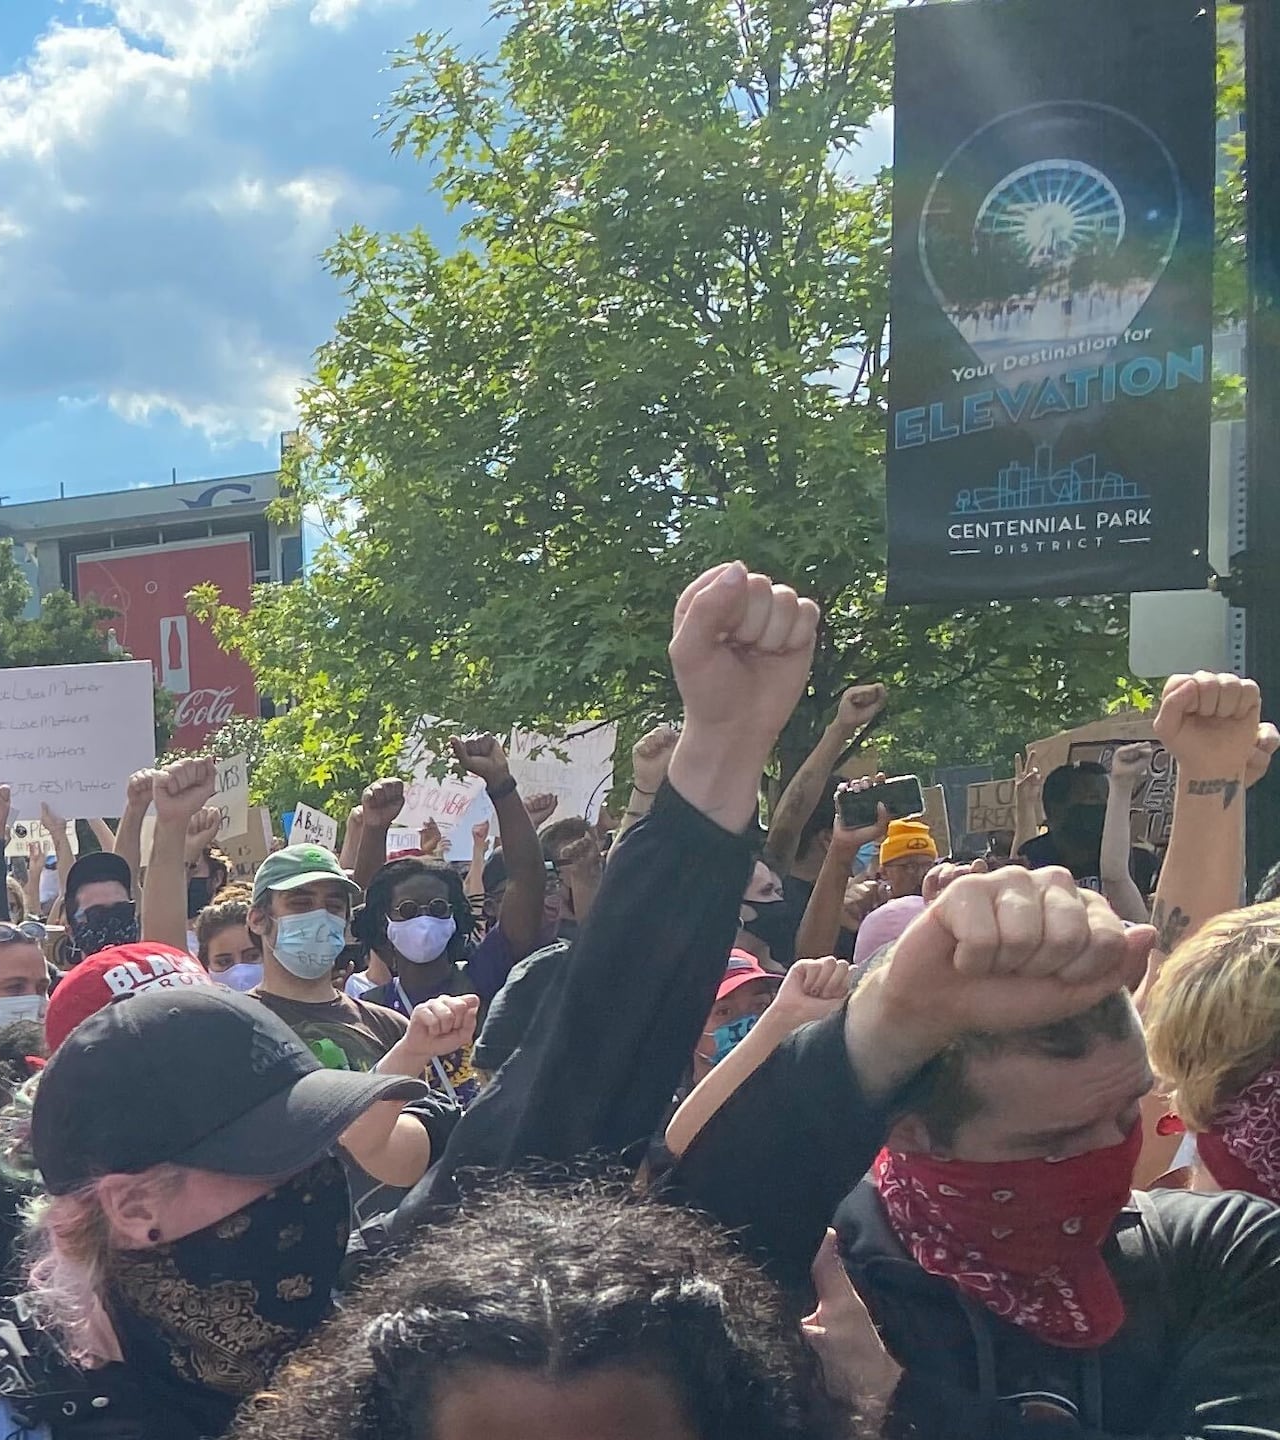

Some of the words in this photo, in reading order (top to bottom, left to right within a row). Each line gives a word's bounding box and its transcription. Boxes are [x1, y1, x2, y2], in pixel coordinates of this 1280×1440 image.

[951, 362, 997, 384] Your
[1003, 336, 1118, 371] Destination
[1124, 326, 1153, 345] for
[895, 345, 1204, 450] ELEVATION
[948, 512, 1086, 540] CENTENNIAL
[1096, 507, 1152, 529] PARK
[994, 537, 1105, 556] DISTRICT
[174, 686, 240, 727] Cola
